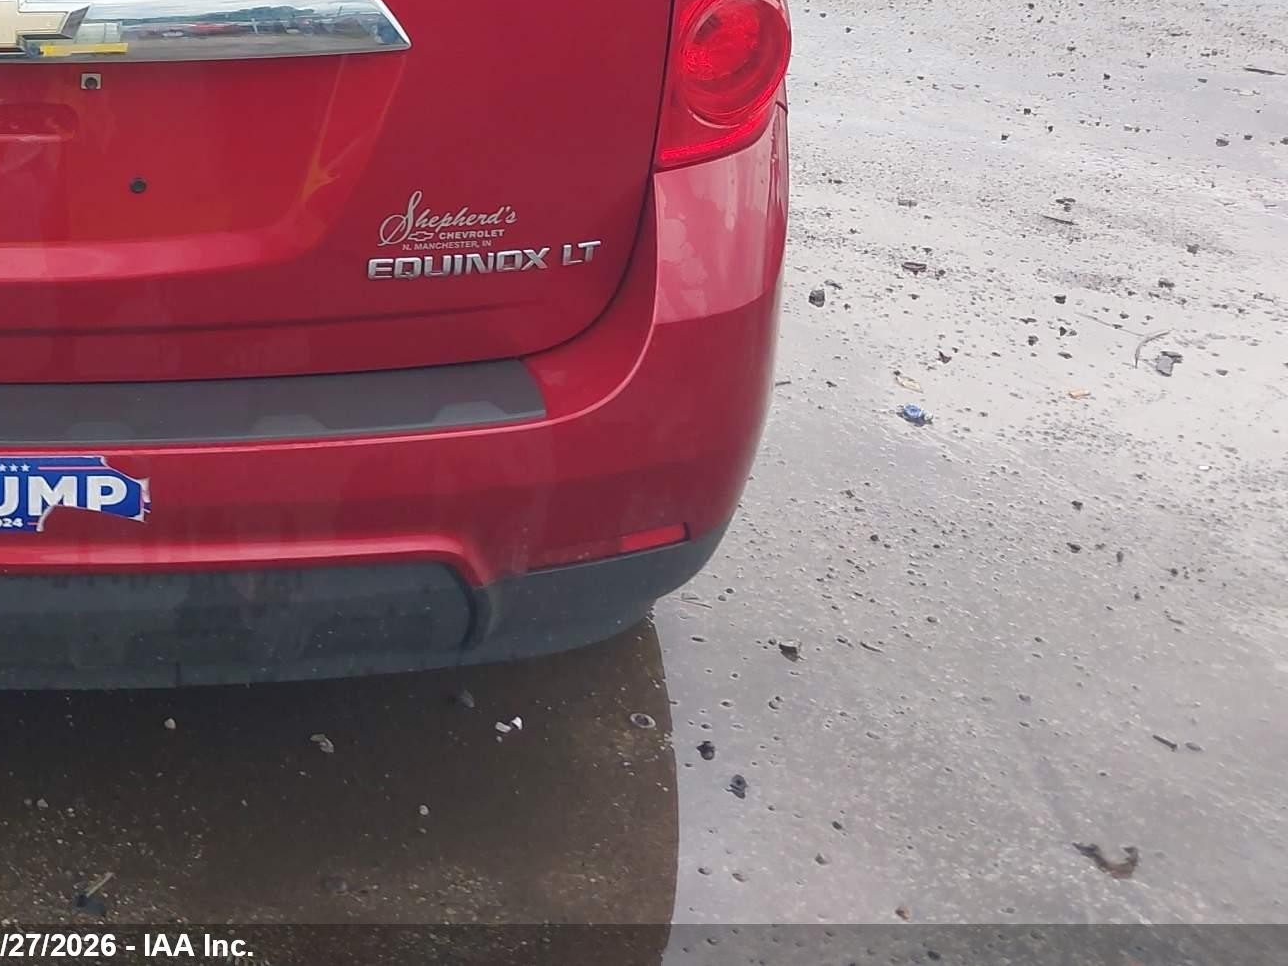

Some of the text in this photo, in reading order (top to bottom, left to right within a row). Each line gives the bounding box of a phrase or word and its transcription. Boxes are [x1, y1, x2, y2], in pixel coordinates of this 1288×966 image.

[377, 190, 517, 247] Shepherd's
[414, 240, 480, 251] MANCHESTER,
[439, 229, 505, 240] CHEVROLET
[367, 240, 601, 281] EQUINOX LT
